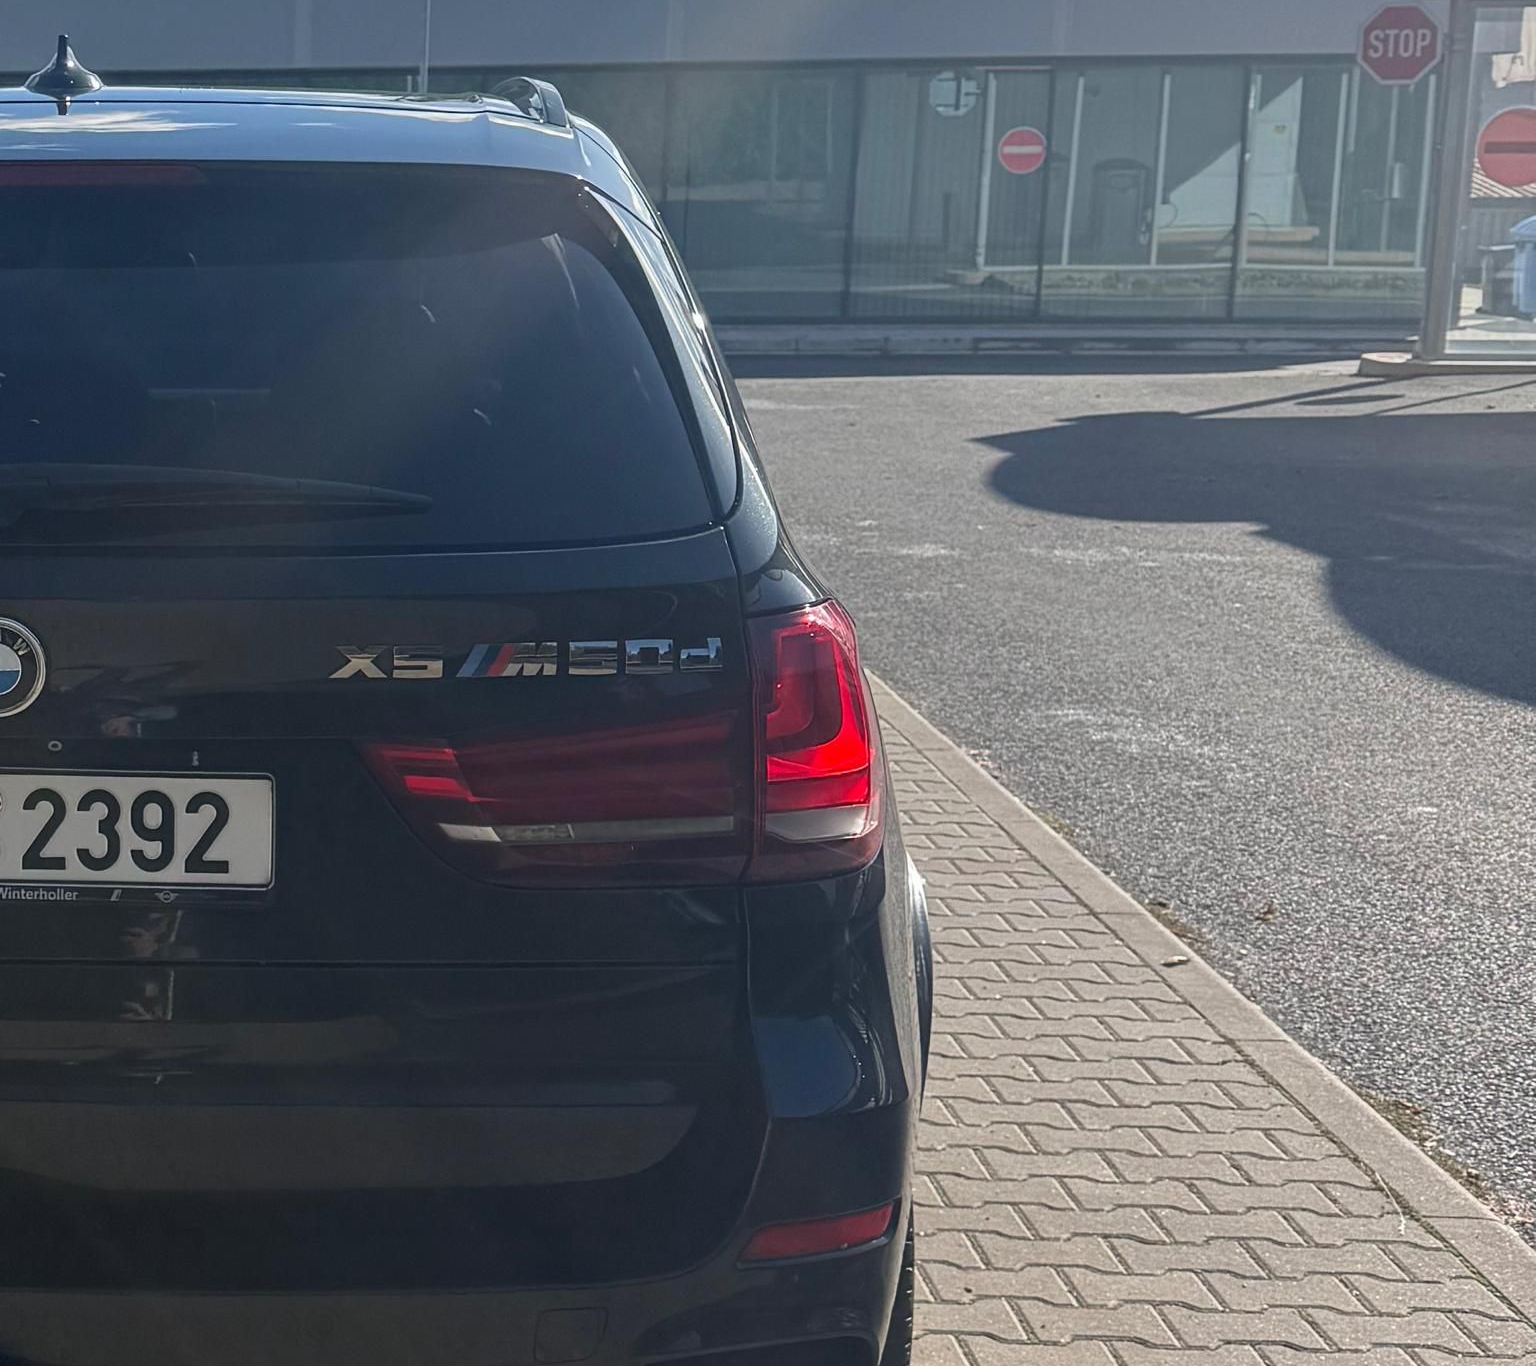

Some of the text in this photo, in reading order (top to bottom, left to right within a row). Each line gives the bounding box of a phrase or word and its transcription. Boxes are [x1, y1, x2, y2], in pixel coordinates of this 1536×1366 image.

[1369, 29, 1431, 58] STOP
[329, 645, 443, 679] X5
[21, 788, 231, 875] 2392
